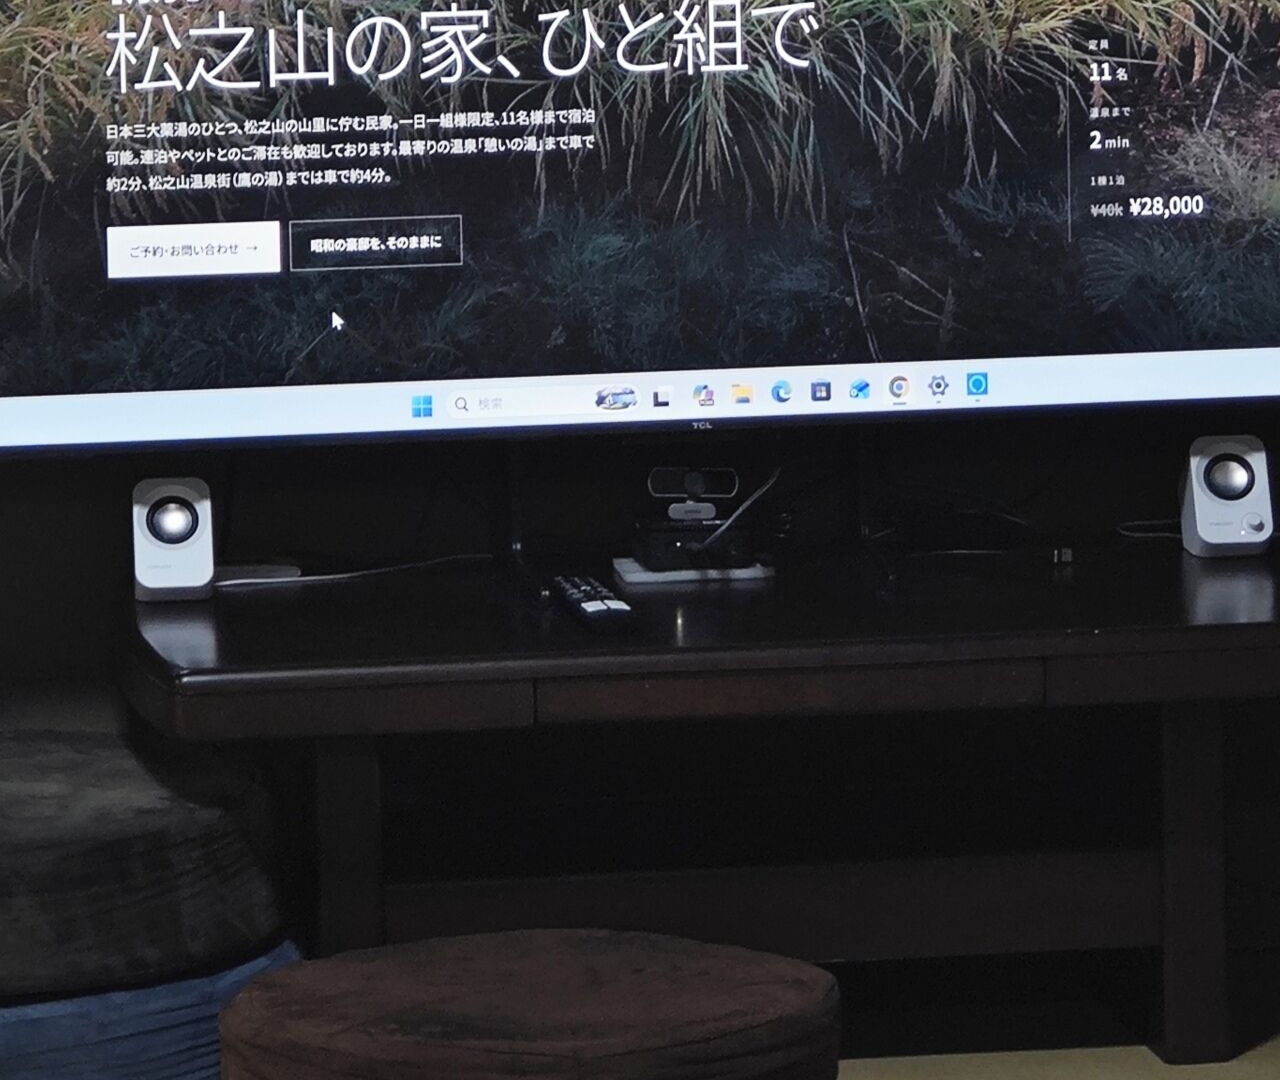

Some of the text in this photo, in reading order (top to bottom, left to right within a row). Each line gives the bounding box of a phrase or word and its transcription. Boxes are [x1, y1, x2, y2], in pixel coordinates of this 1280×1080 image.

[1089, 62, 1128, 81] 11 名
[1089, 130, 1130, 150] 2 min
[1129, 195, 1204, 220] ¥28,000
[691, 421, 713, 430] TCL
